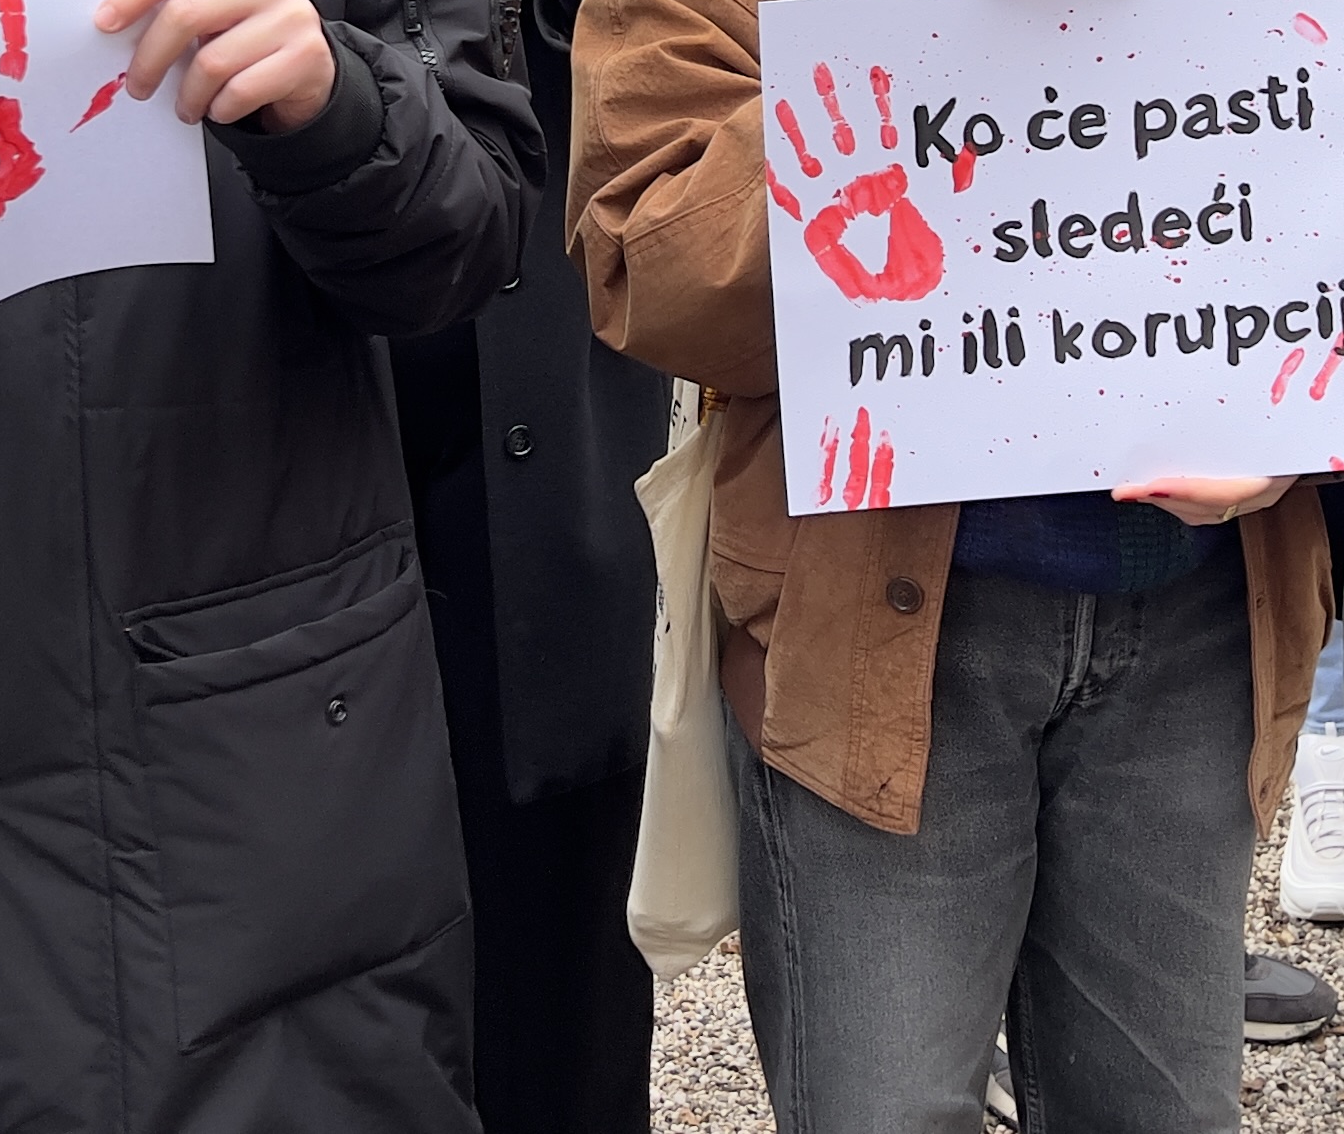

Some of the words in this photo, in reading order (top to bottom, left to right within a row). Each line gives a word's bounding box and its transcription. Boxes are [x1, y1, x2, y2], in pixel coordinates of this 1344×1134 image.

[913, 97, 1004, 168] Ko
[1134, 67, 1313, 160] pasti
[992, 182, 1253, 263] sledeći
[849, 318, 936, 386] mi
[961, 306, 1026, 375] ili
